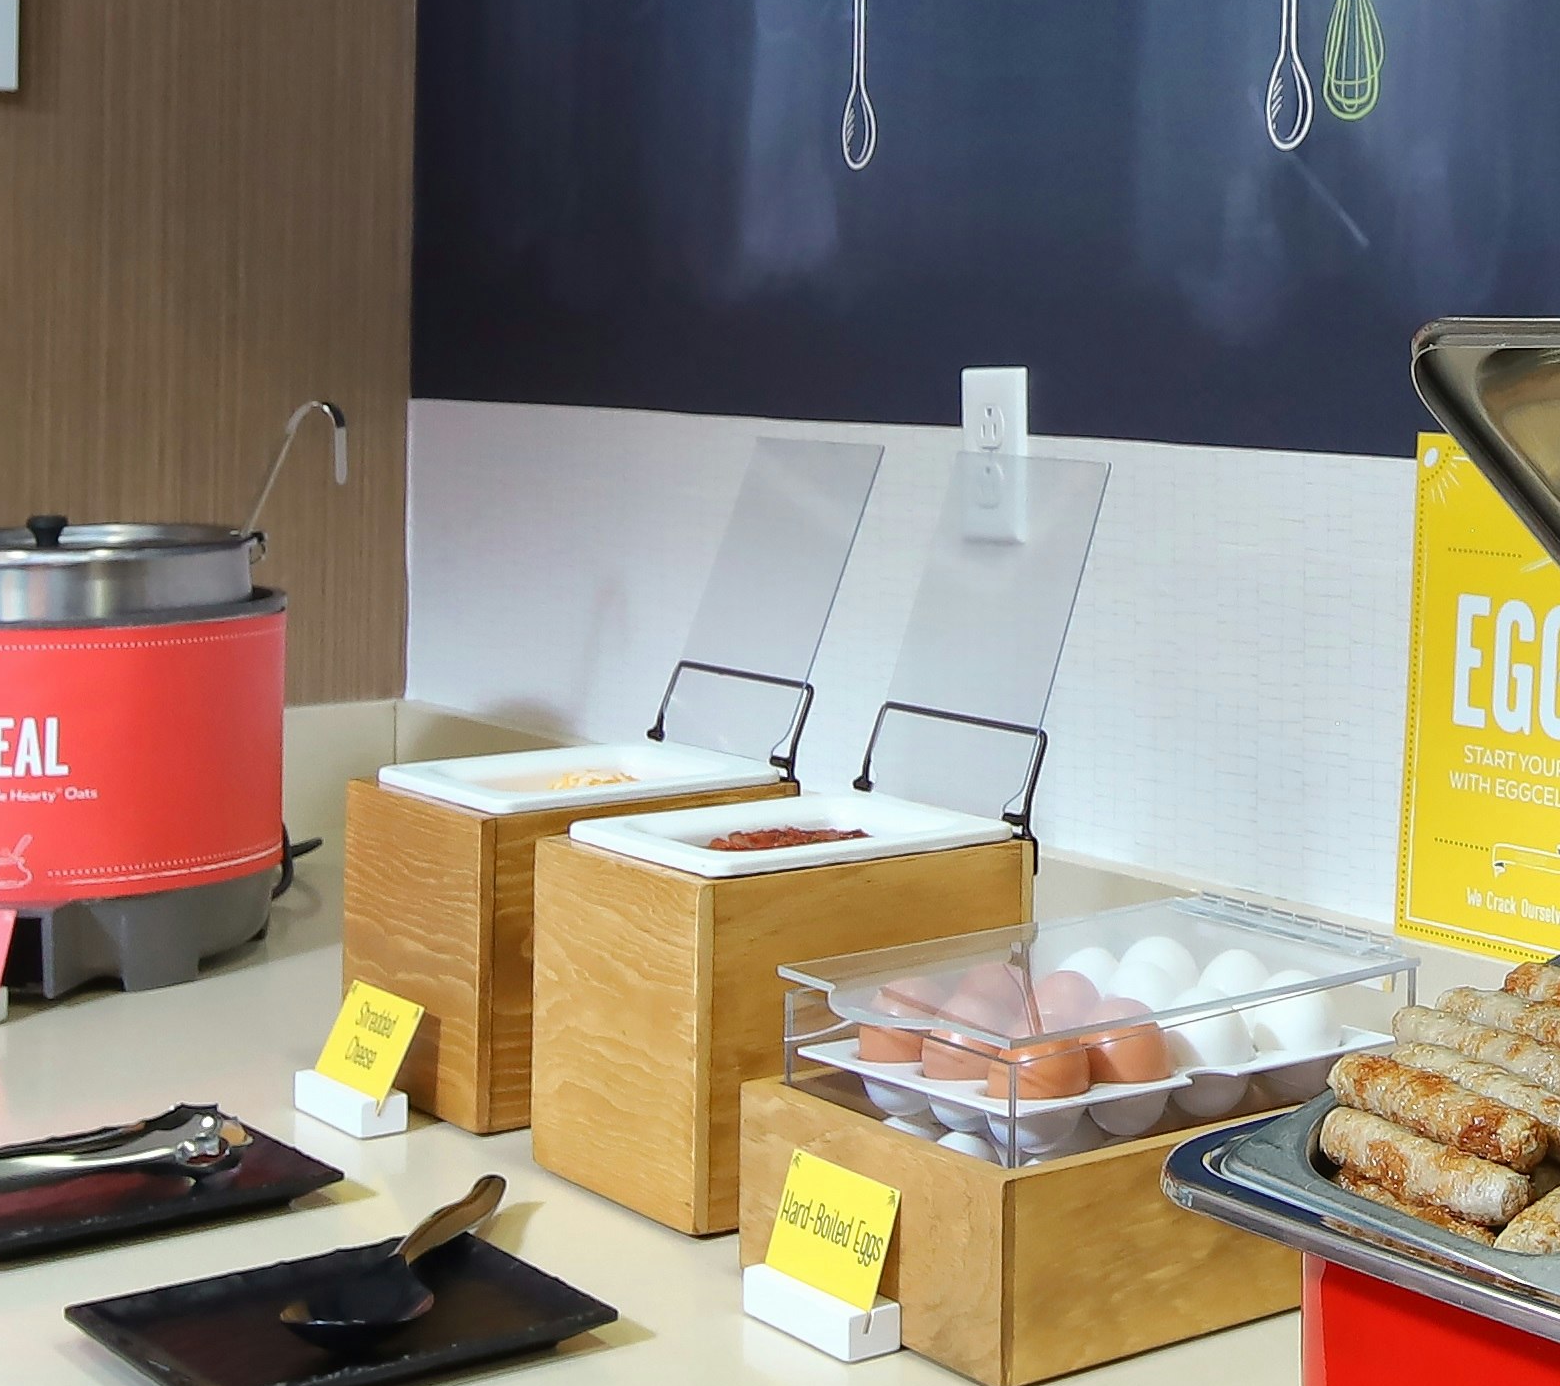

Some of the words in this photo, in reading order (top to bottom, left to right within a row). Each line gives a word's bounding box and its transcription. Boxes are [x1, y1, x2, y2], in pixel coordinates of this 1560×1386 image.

[1464, 745, 1516, 771] START
[64, 786, 98, 801] Oats
[1449, 770, 1491, 794] WITH
[1467, 887, 1482, 908] We
[1486, 891, 1517, 915] Crack
[780, 1189, 854, 1248] Hard-Boiled
[853, 1220, 883, 1267] Eggs
